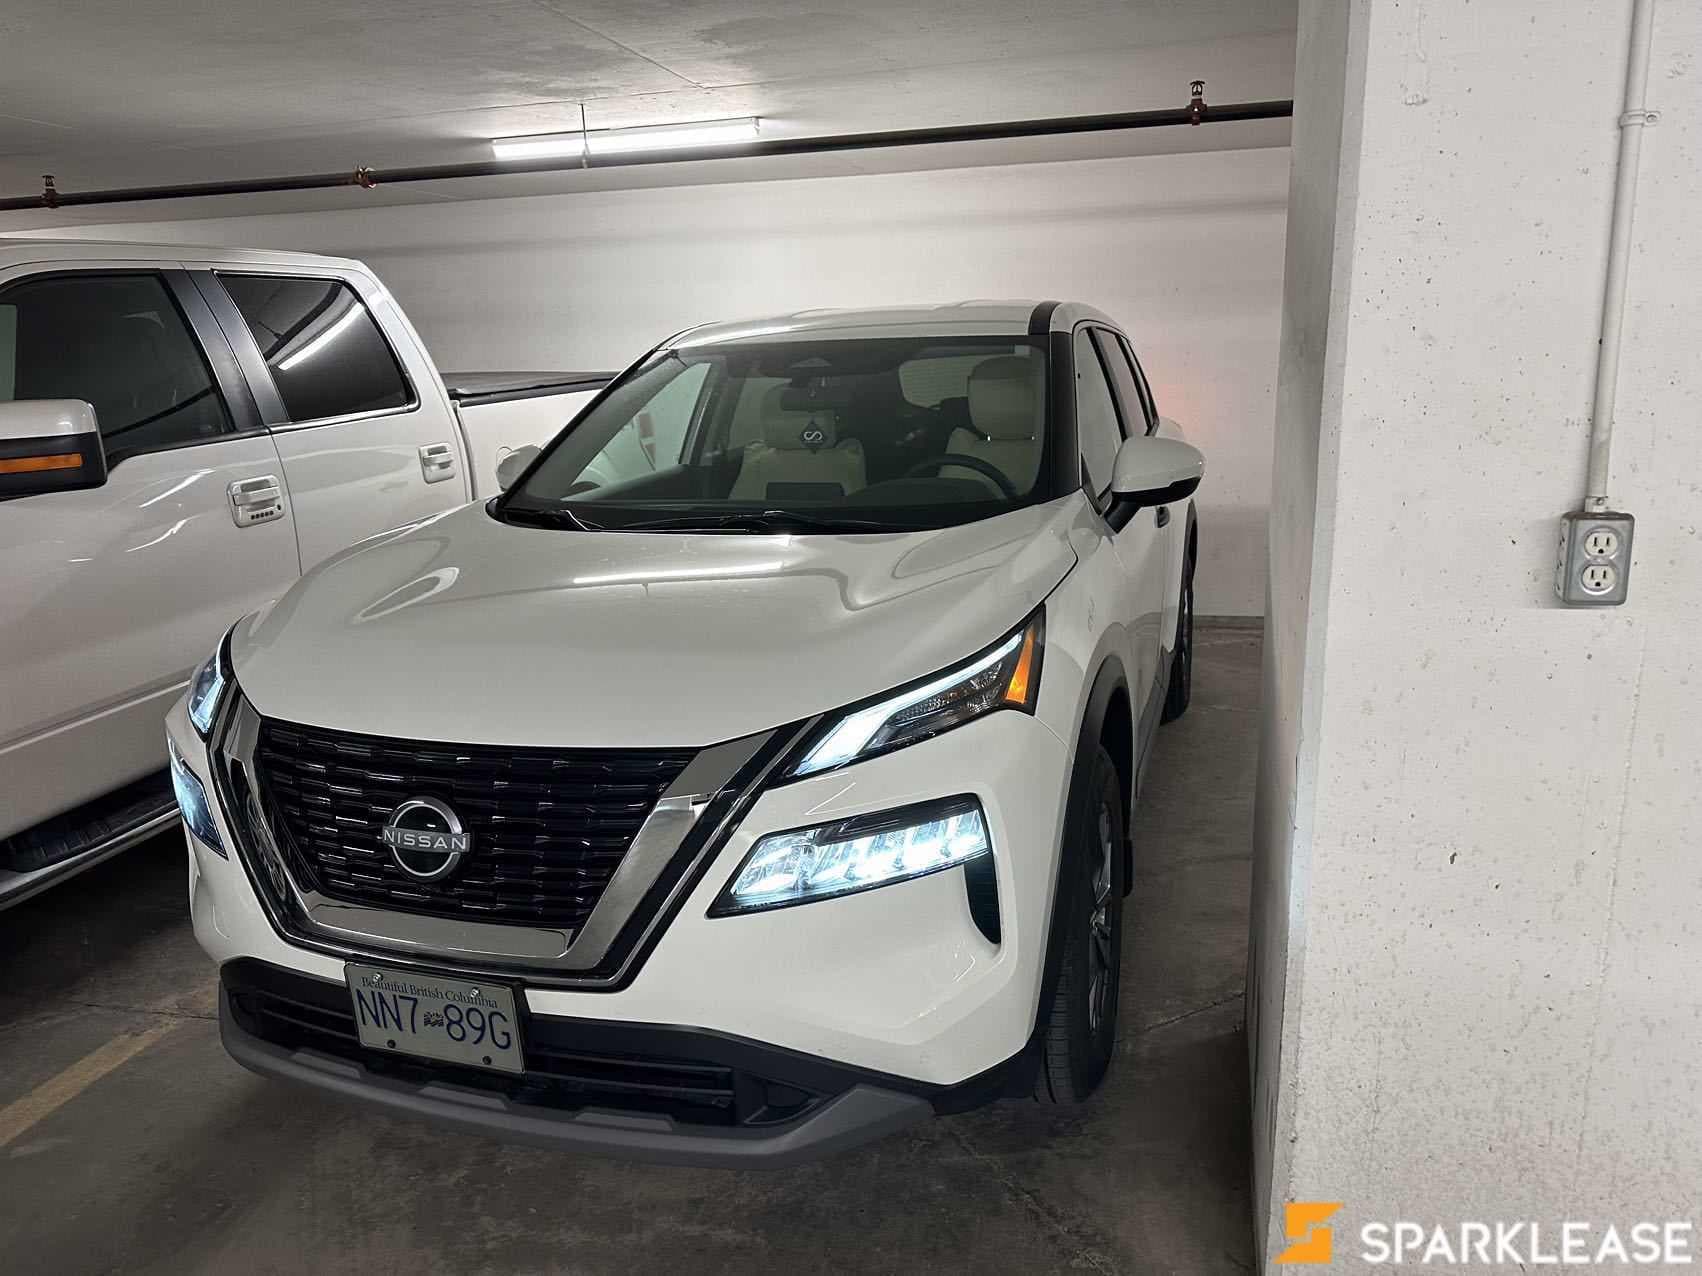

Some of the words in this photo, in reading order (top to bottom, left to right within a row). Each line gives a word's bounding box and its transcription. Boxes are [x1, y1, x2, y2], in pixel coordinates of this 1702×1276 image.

[384, 829, 467, 850] NISSAN
[409, 984, 445, 1000] British
[356, 989, 418, 1034] NN7
[443, 1004, 511, 1050] 89G
